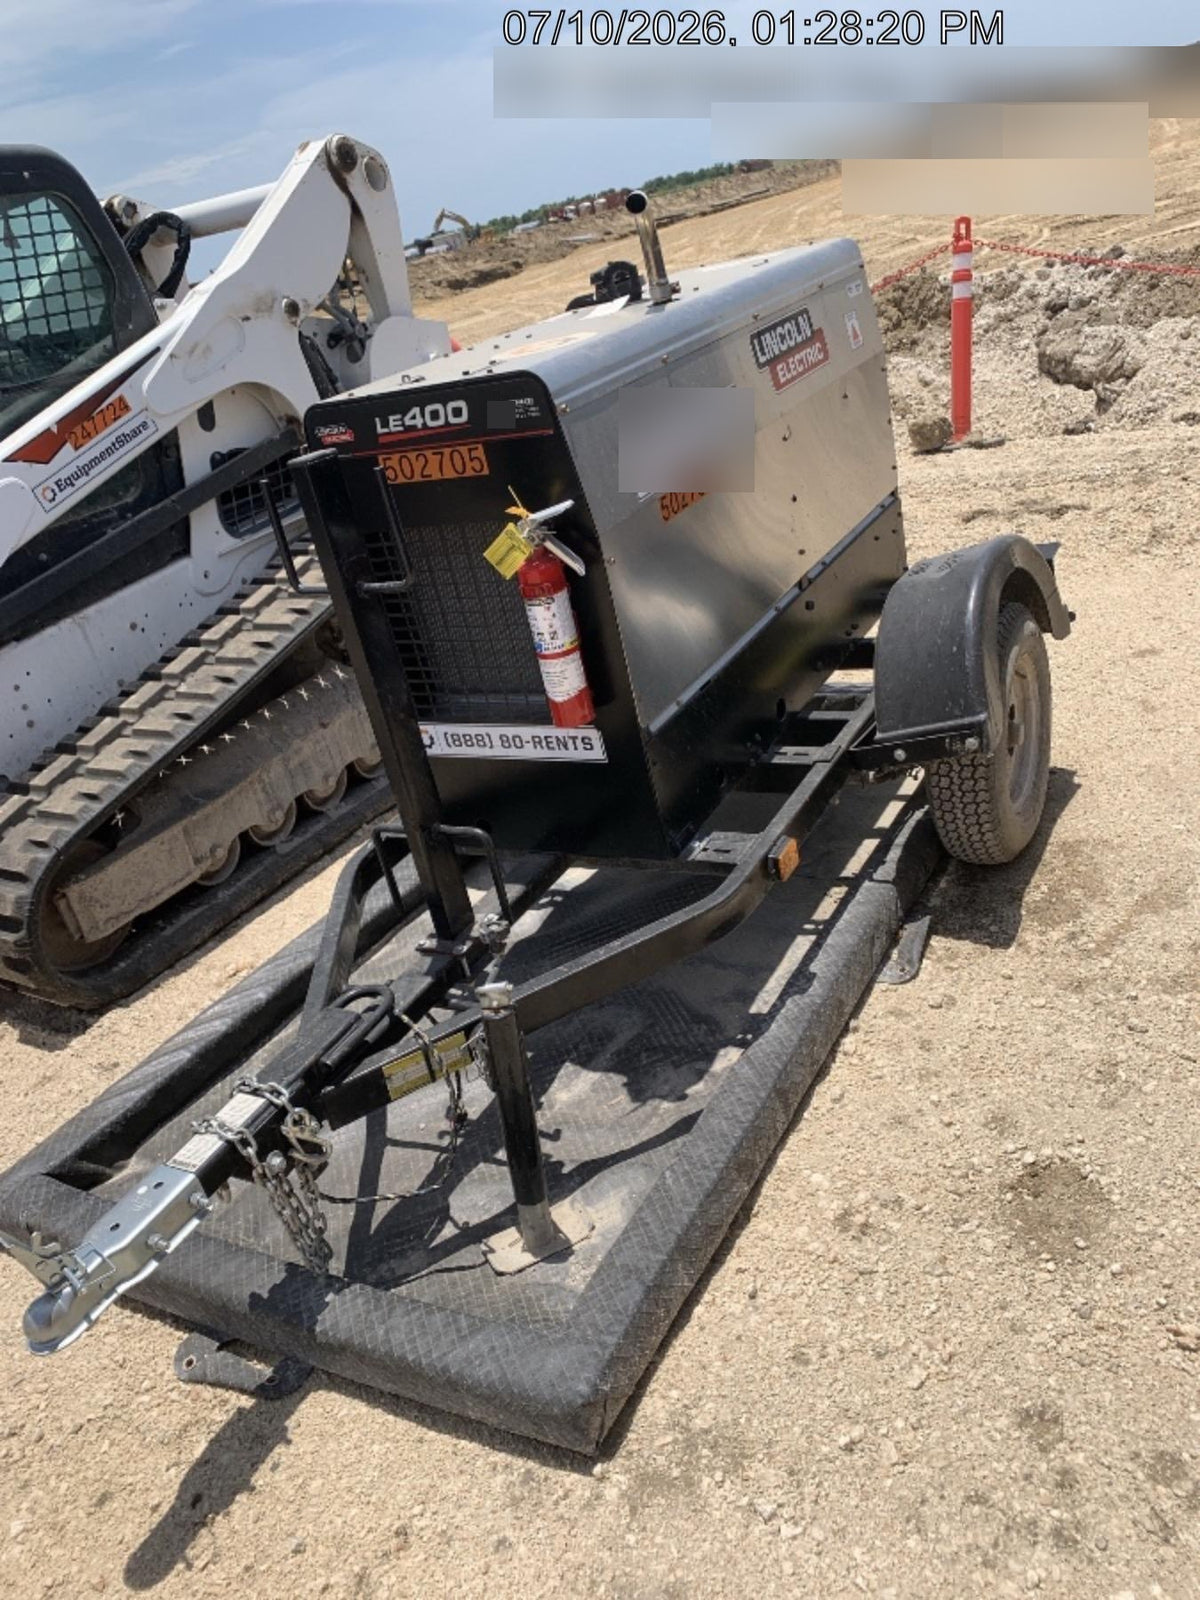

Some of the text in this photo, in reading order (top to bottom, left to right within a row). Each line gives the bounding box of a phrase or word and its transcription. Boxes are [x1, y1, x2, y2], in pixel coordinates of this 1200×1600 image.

[753, 313, 814, 364] LINCOLN
[776, 342, 824, 384] ELECTRIC
[69, 399, 130, 448] 247724
[375, 400, 468, 434] LE400
[55, 420, 150, 493] EquipmentShare
[383, 447, 484, 482] 502705
[444, 731, 595, 752] (888) 80-RENTS
